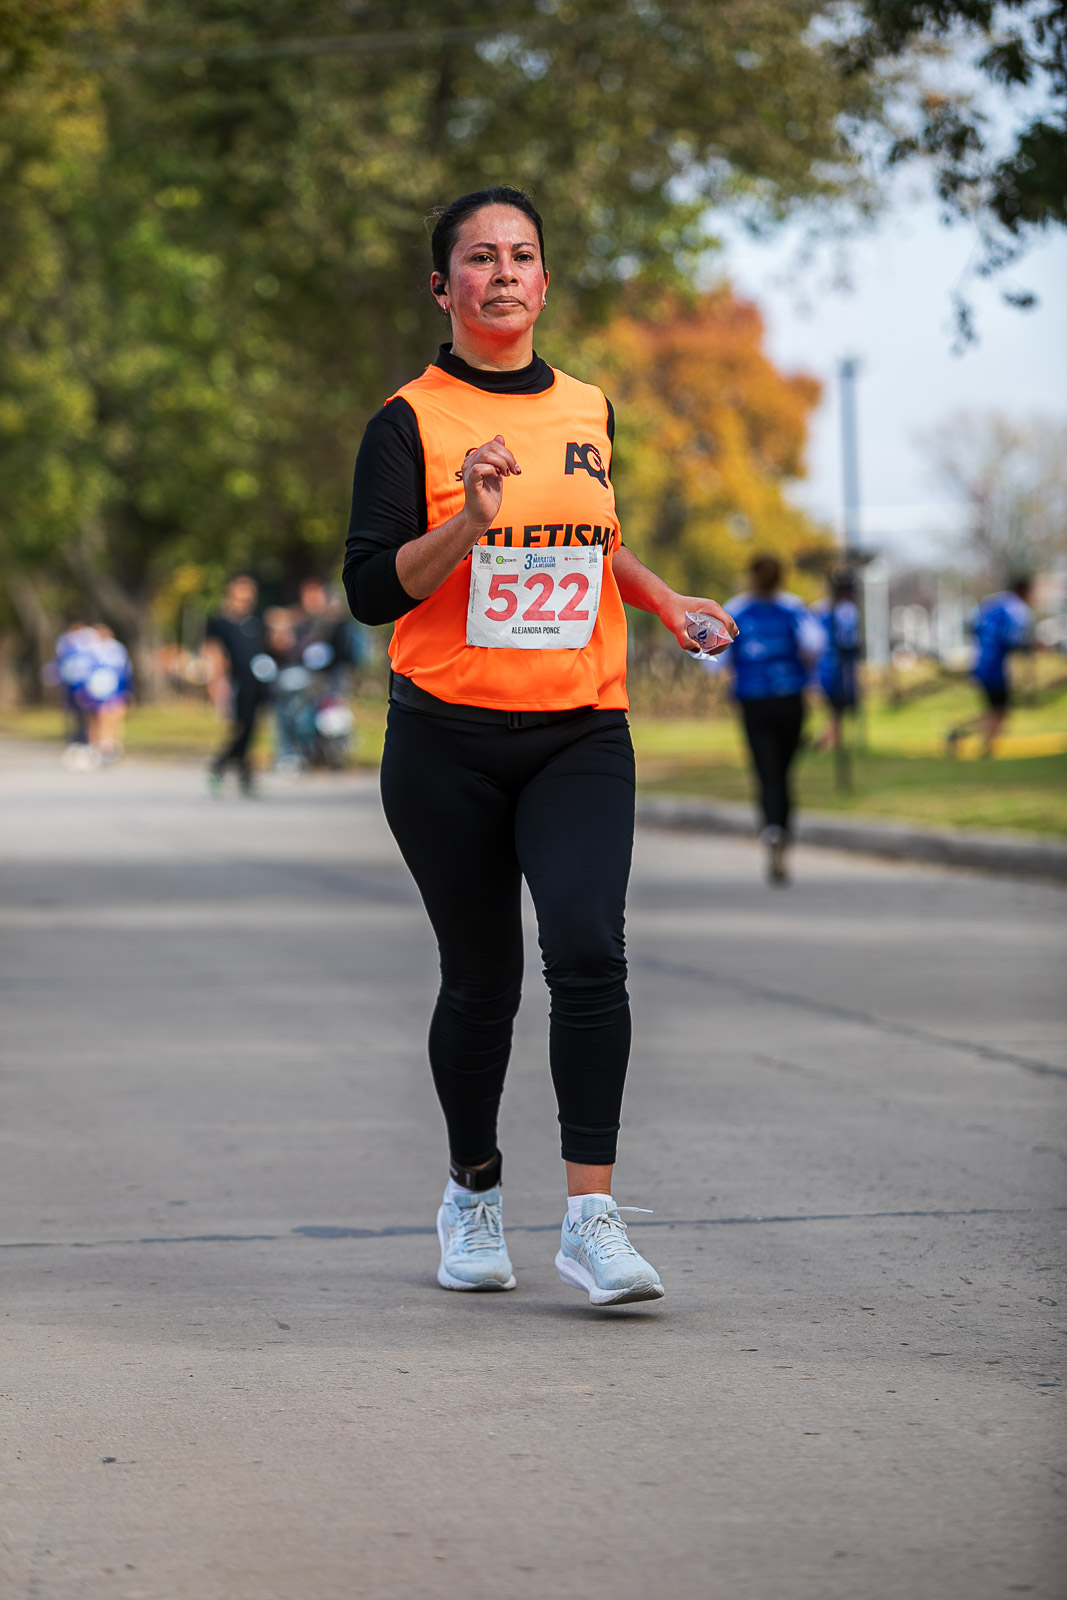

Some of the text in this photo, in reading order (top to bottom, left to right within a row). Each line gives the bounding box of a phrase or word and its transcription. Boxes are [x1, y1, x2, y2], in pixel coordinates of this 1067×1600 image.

[480, 523, 616, 556] TLETISM
[484, 572, 590, 622] 522
[511, 626, 561, 635] ALEJANDRA PONCE
